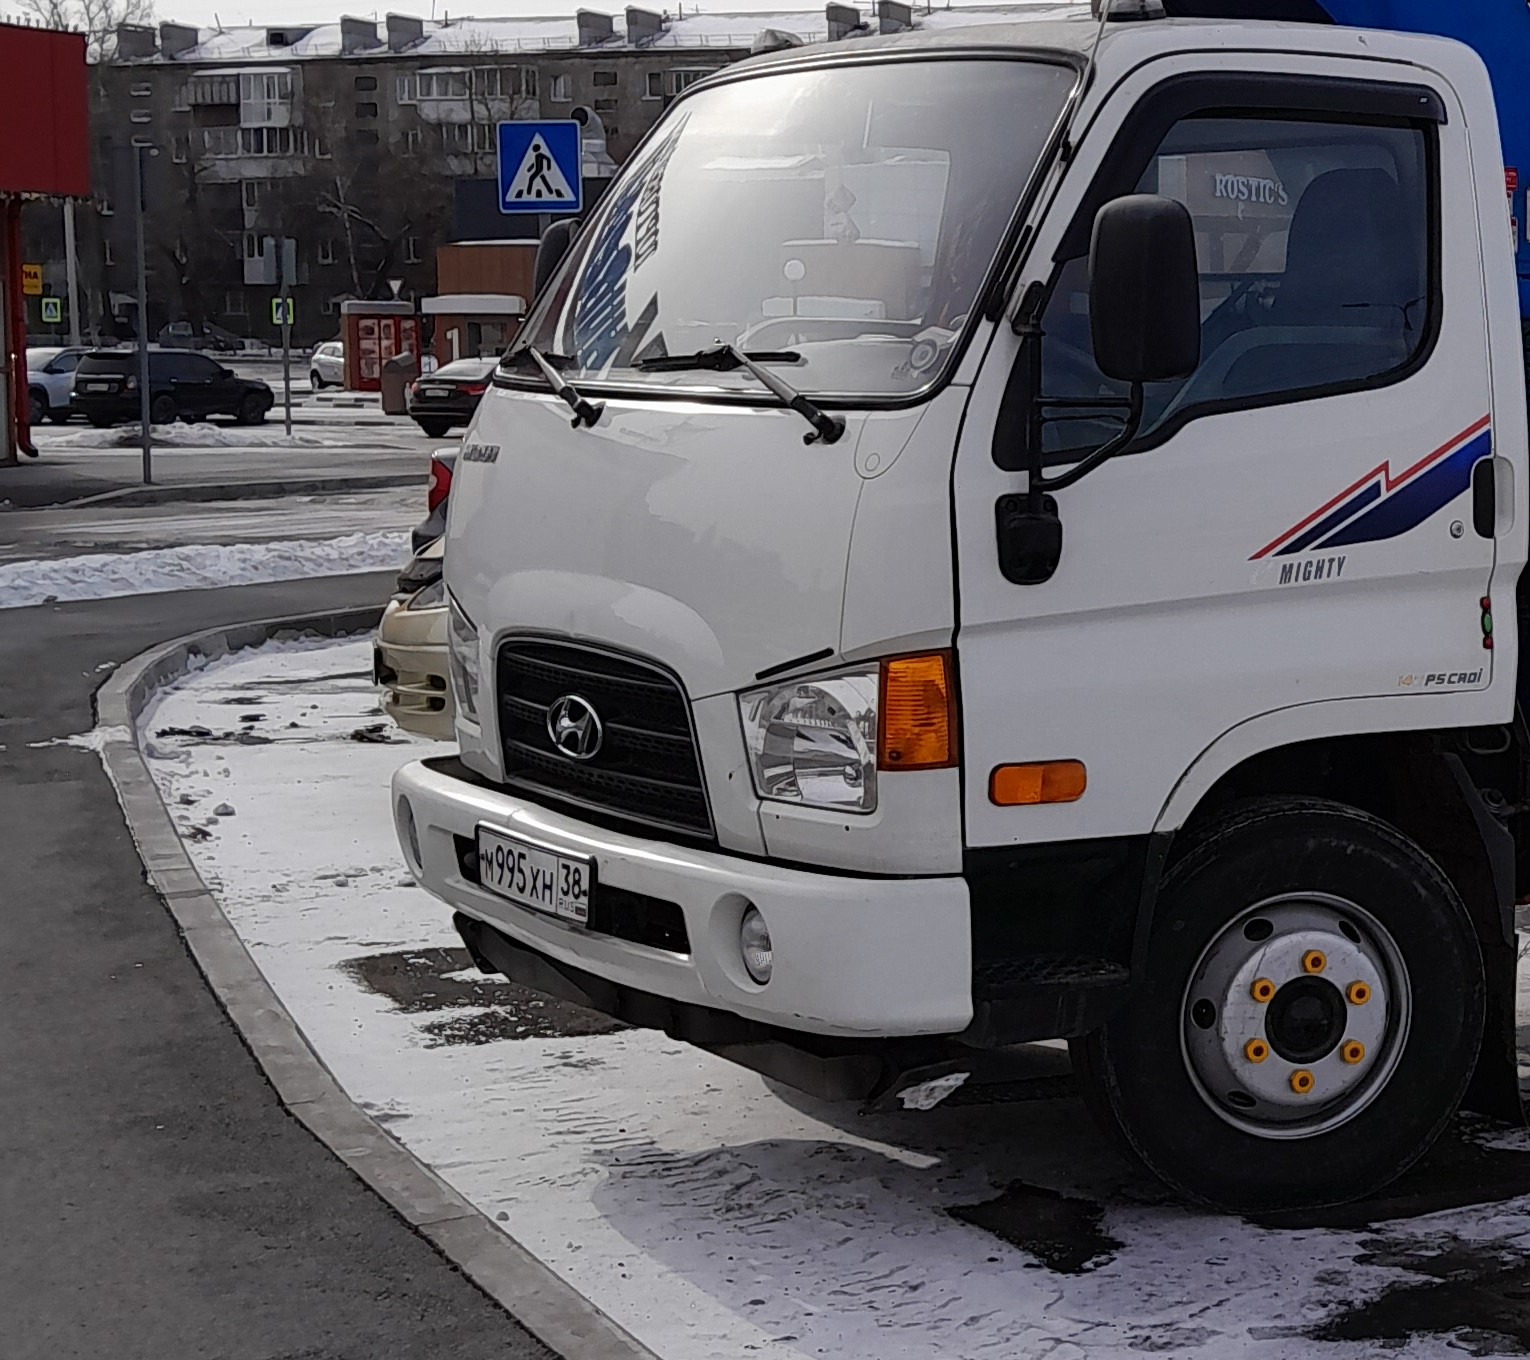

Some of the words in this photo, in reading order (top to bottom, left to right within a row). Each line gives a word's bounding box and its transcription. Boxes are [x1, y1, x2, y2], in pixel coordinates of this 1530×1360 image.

[1215, 173, 1288, 206] ROSTIC'S
[1279, 555, 1346, 585] MIGHTY
[561, 863, 582, 900] 38
